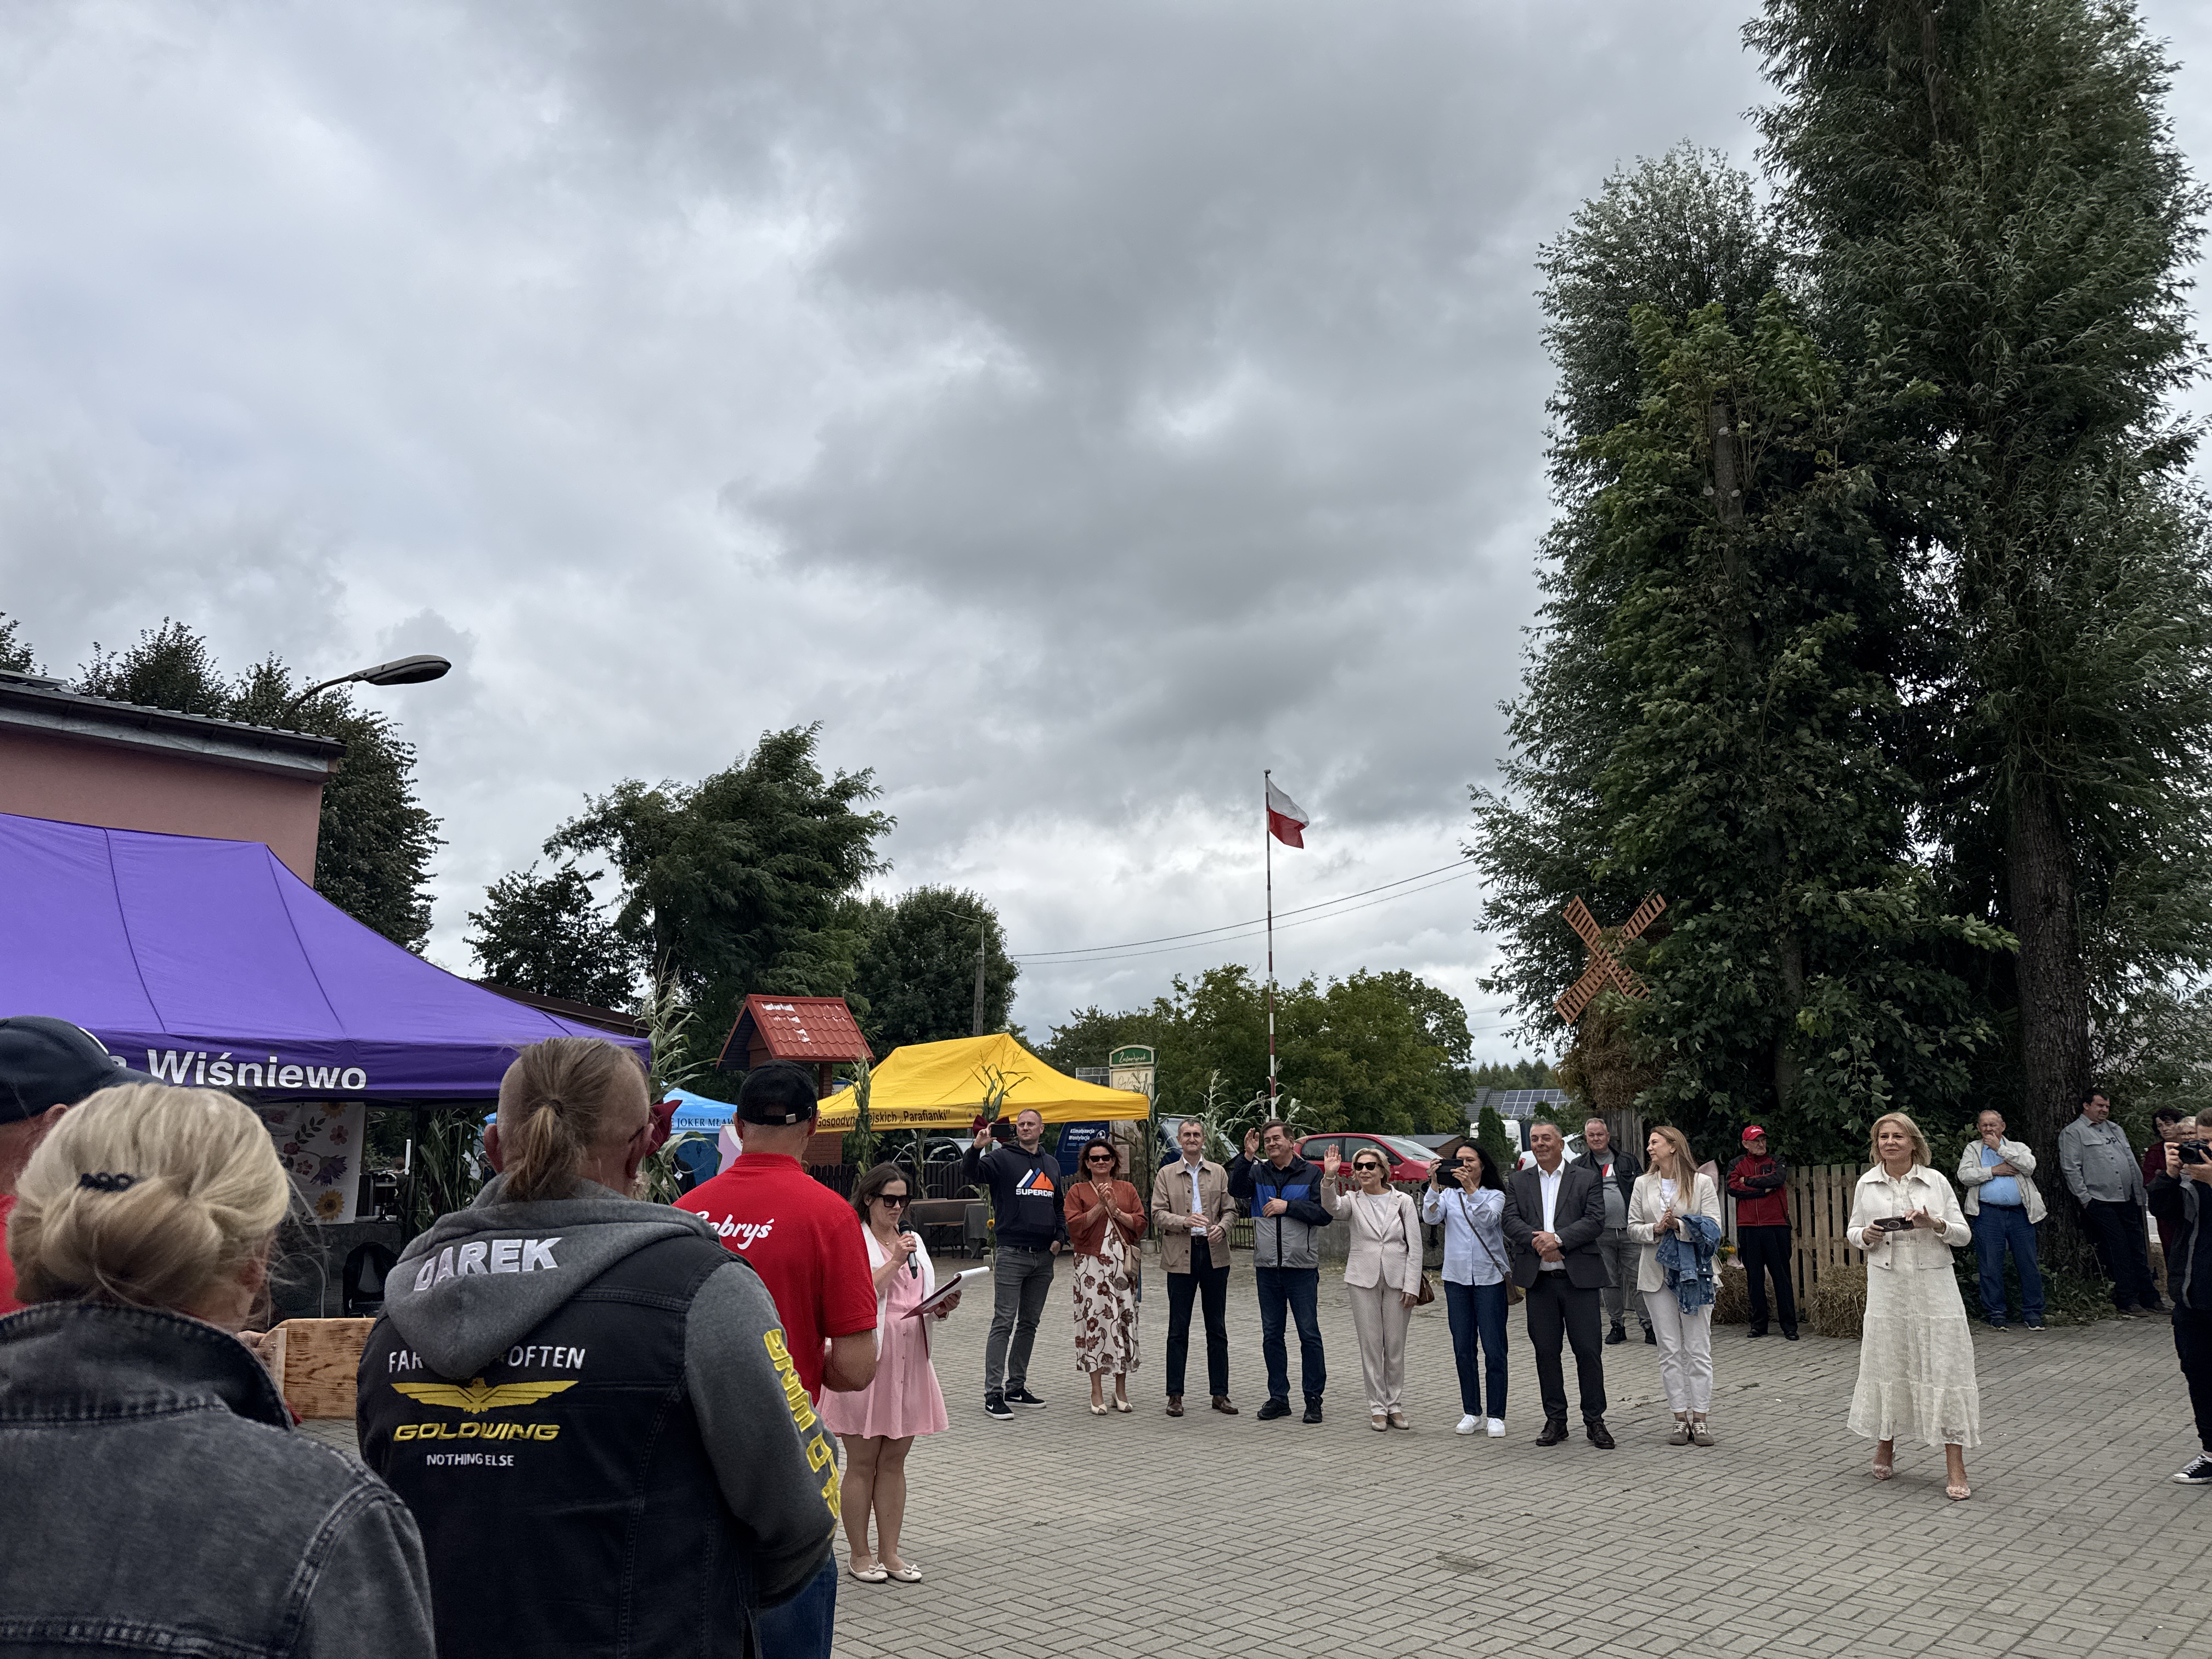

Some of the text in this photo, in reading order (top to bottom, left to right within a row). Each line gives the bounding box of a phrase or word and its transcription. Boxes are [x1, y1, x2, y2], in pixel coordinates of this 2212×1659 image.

[146, 1049, 367, 1090] Wiśniewo
[677, 1118, 706, 1128] JOKER
[413, 1237, 563, 1291] DAREK
[507, 1345, 586, 1370] OFTEN
[393, 1422, 561, 1442] GOLDWING
[426, 1453, 515, 1466] NOTHING ELSE
